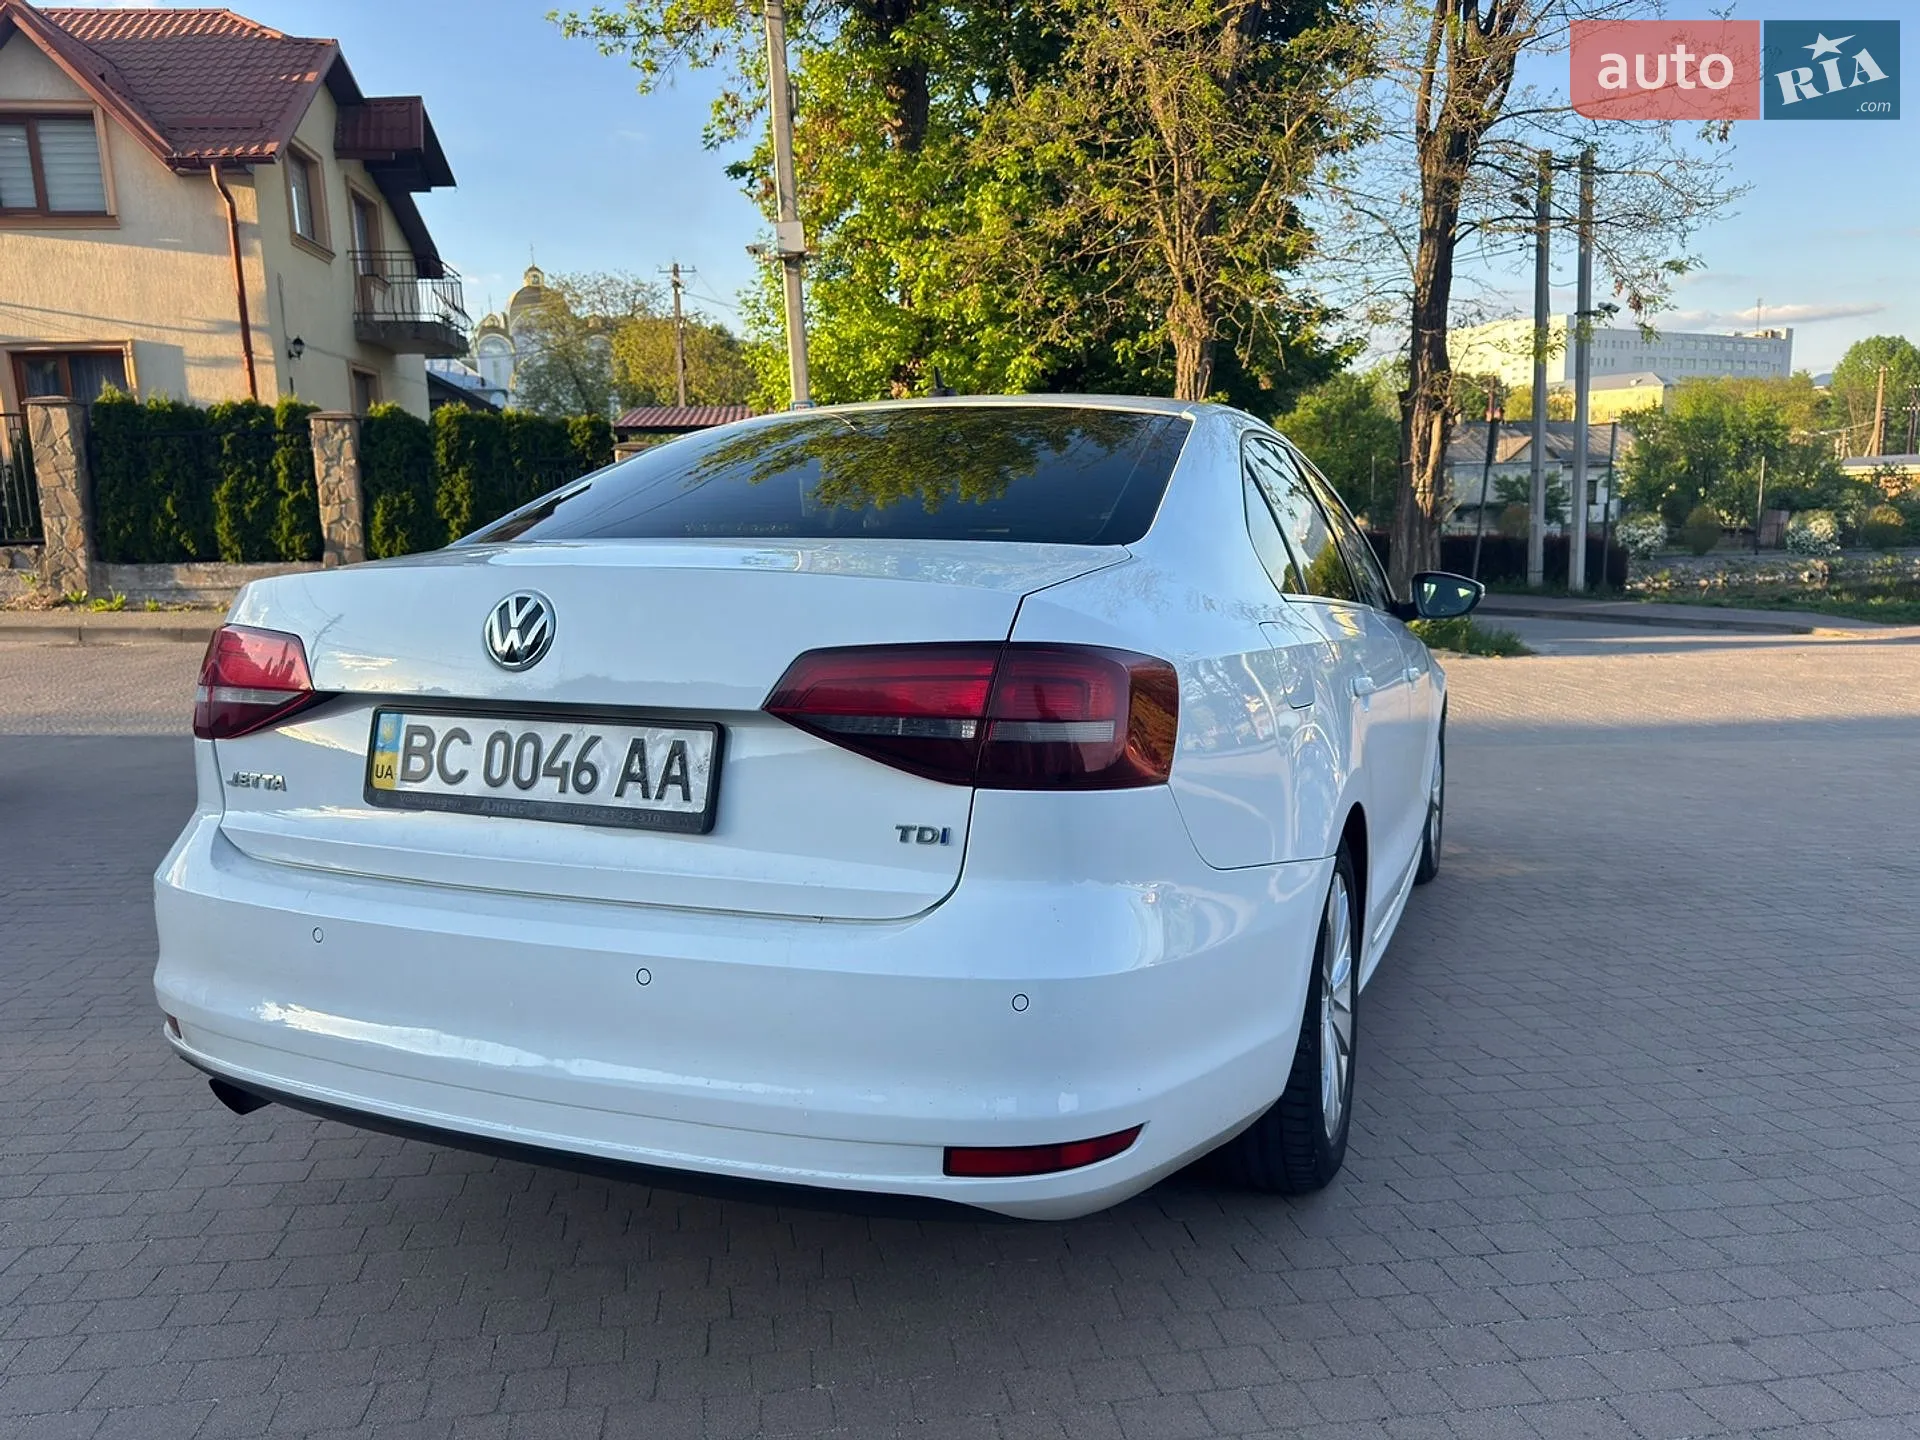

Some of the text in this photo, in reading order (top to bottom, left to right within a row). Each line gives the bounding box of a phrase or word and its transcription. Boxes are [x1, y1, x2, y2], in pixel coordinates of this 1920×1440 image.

[486, 591, 554, 669] VW
[374, 763, 394, 780] UA
[400, 723, 692, 802] BC 0046 AA
[225, 771, 287, 792] JETTA
[895, 824, 951, 846] TDI
